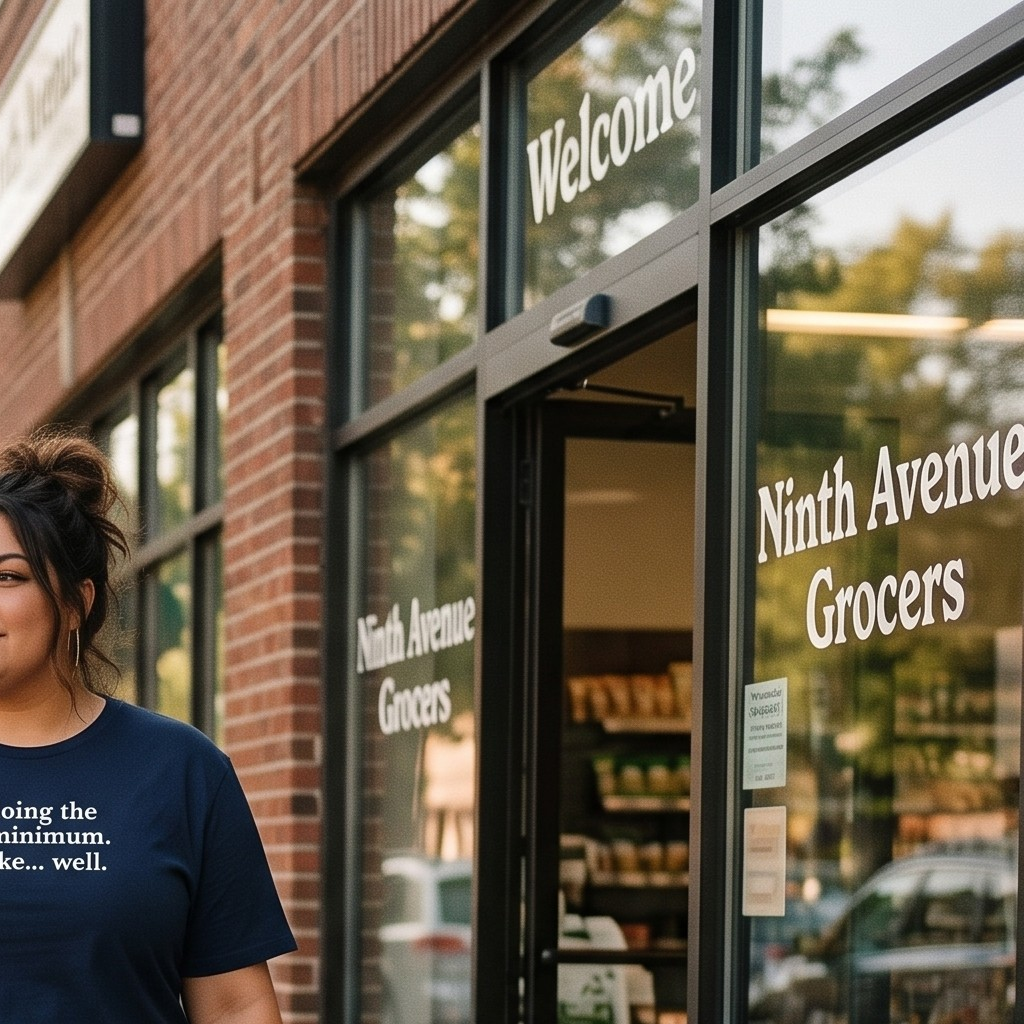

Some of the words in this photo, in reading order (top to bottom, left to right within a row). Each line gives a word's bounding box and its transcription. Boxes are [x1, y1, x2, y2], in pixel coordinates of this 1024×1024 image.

[527, 47, 696, 224] Welcome
[757, 456, 858, 563] Ninth
[867, 423, 1024, 530] Avenue
[357, 603, 405, 674] Ninth
[406, 597, 476, 658] Avenue
[806, 558, 965, 649] Grocers
[378, 677, 452, 735] Grocers
[60, 801, 98, 820] the
[52, 852, 107, 871] well.
